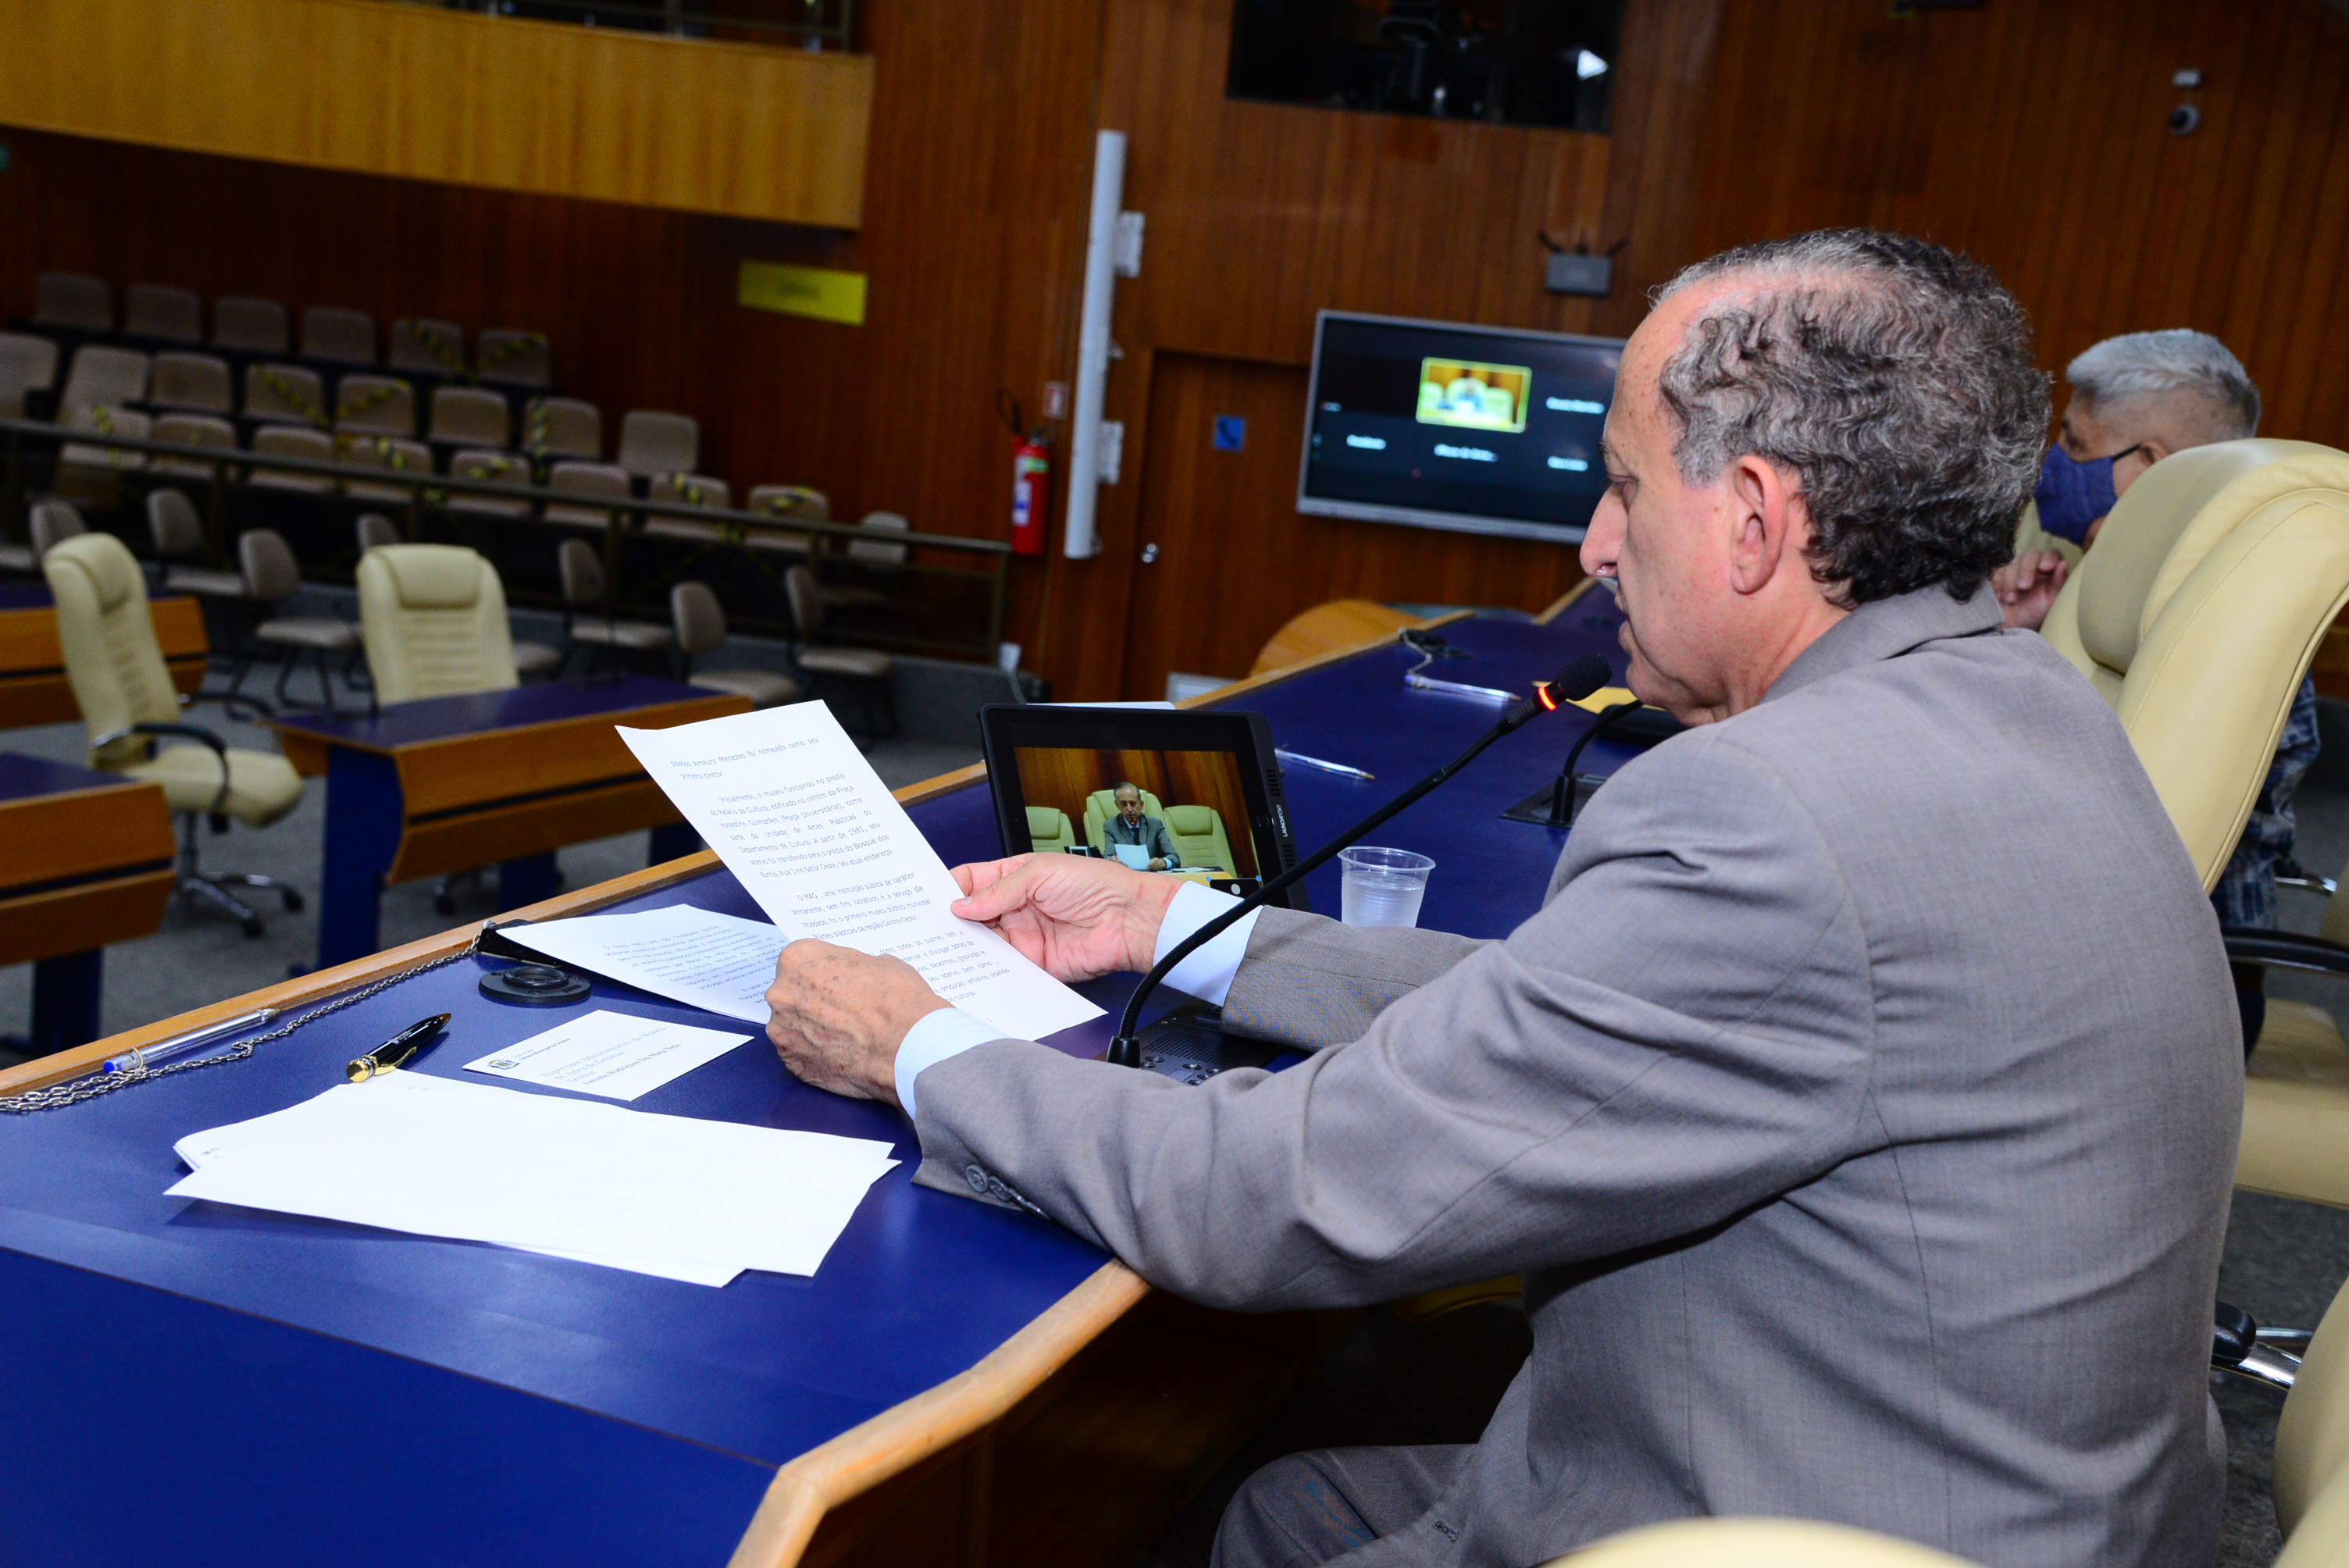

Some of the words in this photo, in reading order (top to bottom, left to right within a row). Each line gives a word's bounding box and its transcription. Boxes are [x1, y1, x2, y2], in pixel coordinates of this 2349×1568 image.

[718, 754, 746, 762] Menezes
[758, 745, 786, 754] nomeado
[784, 782, 814, 793] funcionou
[826, 774, 845, 782] prédio
[771, 800, 797, 809] edificado
[807, 793, 827, 802] centro
[829, 814, 857, 825] Plásticas
[848, 826, 868, 836] 1981,
[854, 839, 877, 850] Bosque
[864, 850, 893, 861] endereço.
[893, 873, 914, 883] caráter
